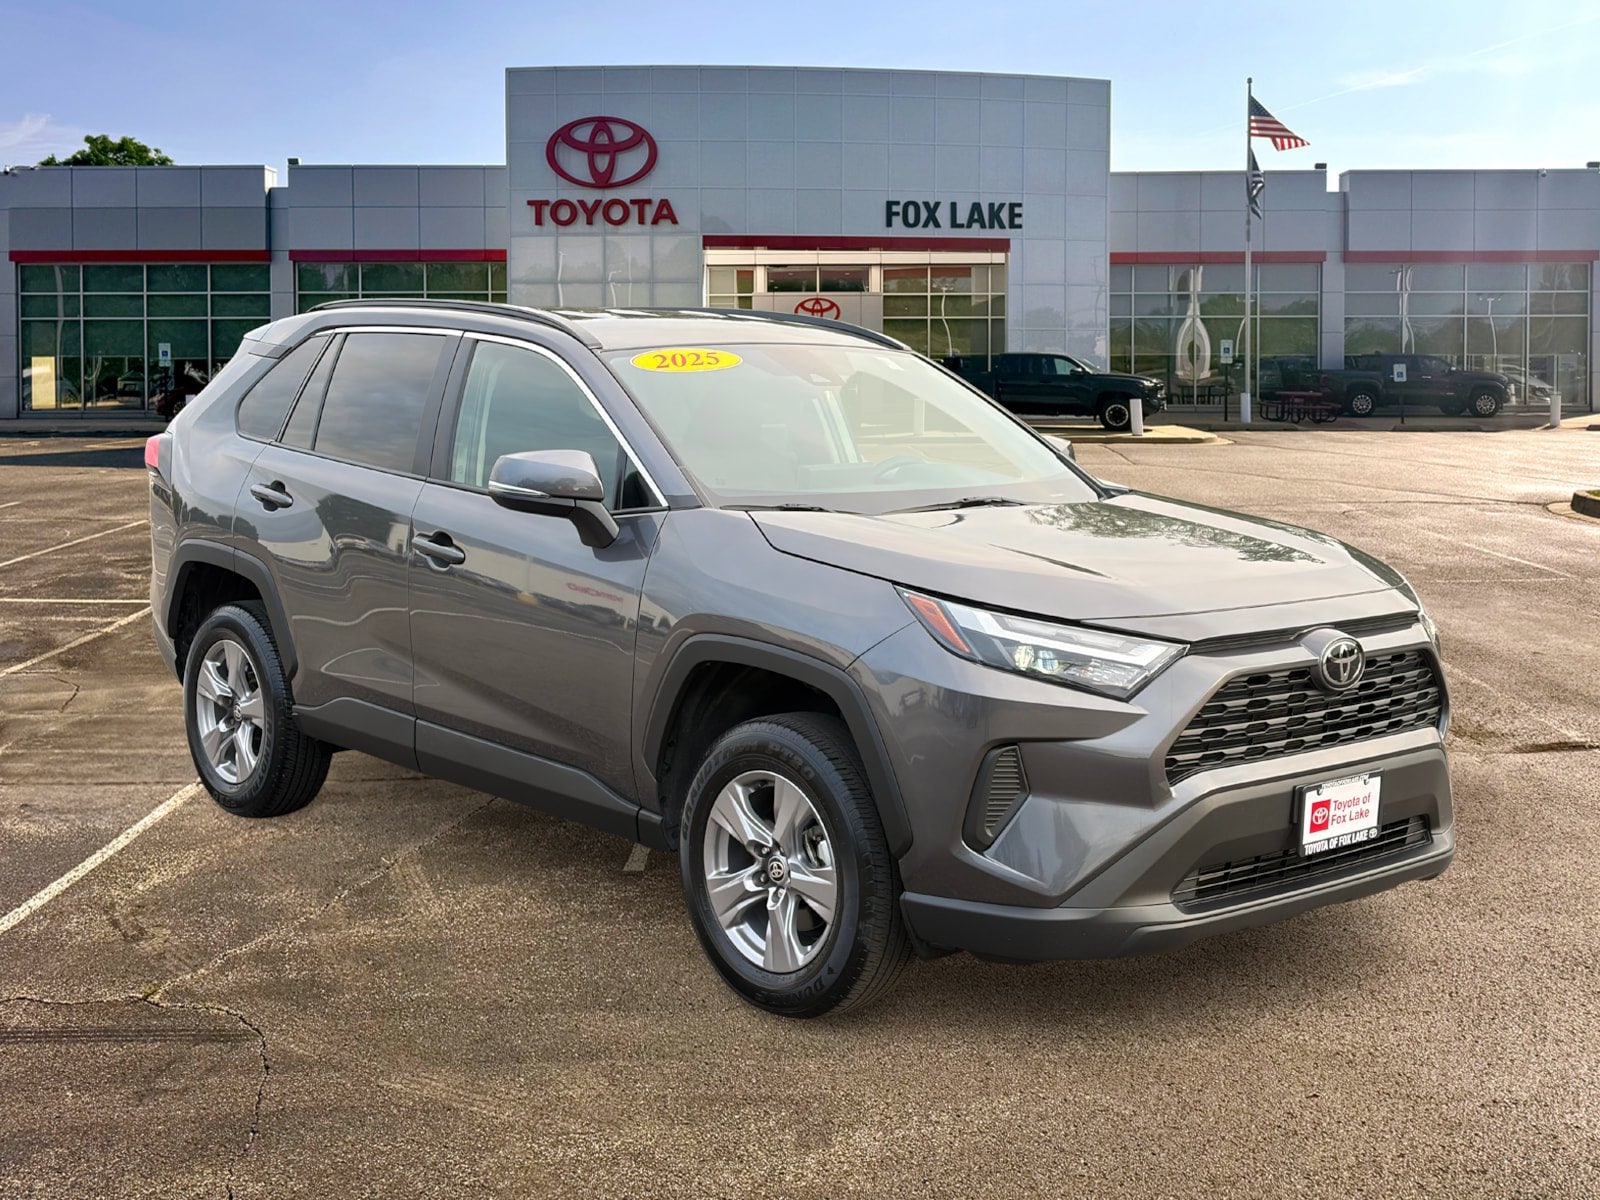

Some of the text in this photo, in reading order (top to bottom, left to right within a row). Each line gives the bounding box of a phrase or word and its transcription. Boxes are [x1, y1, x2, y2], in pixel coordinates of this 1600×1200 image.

[527, 199, 678, 226] TOYOTA
[885, 201, 1023, 229] FOX LAKE
[653, 352, 720, 368] 2025
[1333, 792, 1371, 812] Toyota of
[1331, 808, 1370, 825] Fox Lake
[1304, 830, 1368, 855] TOYOTA OF FOX LAKE
